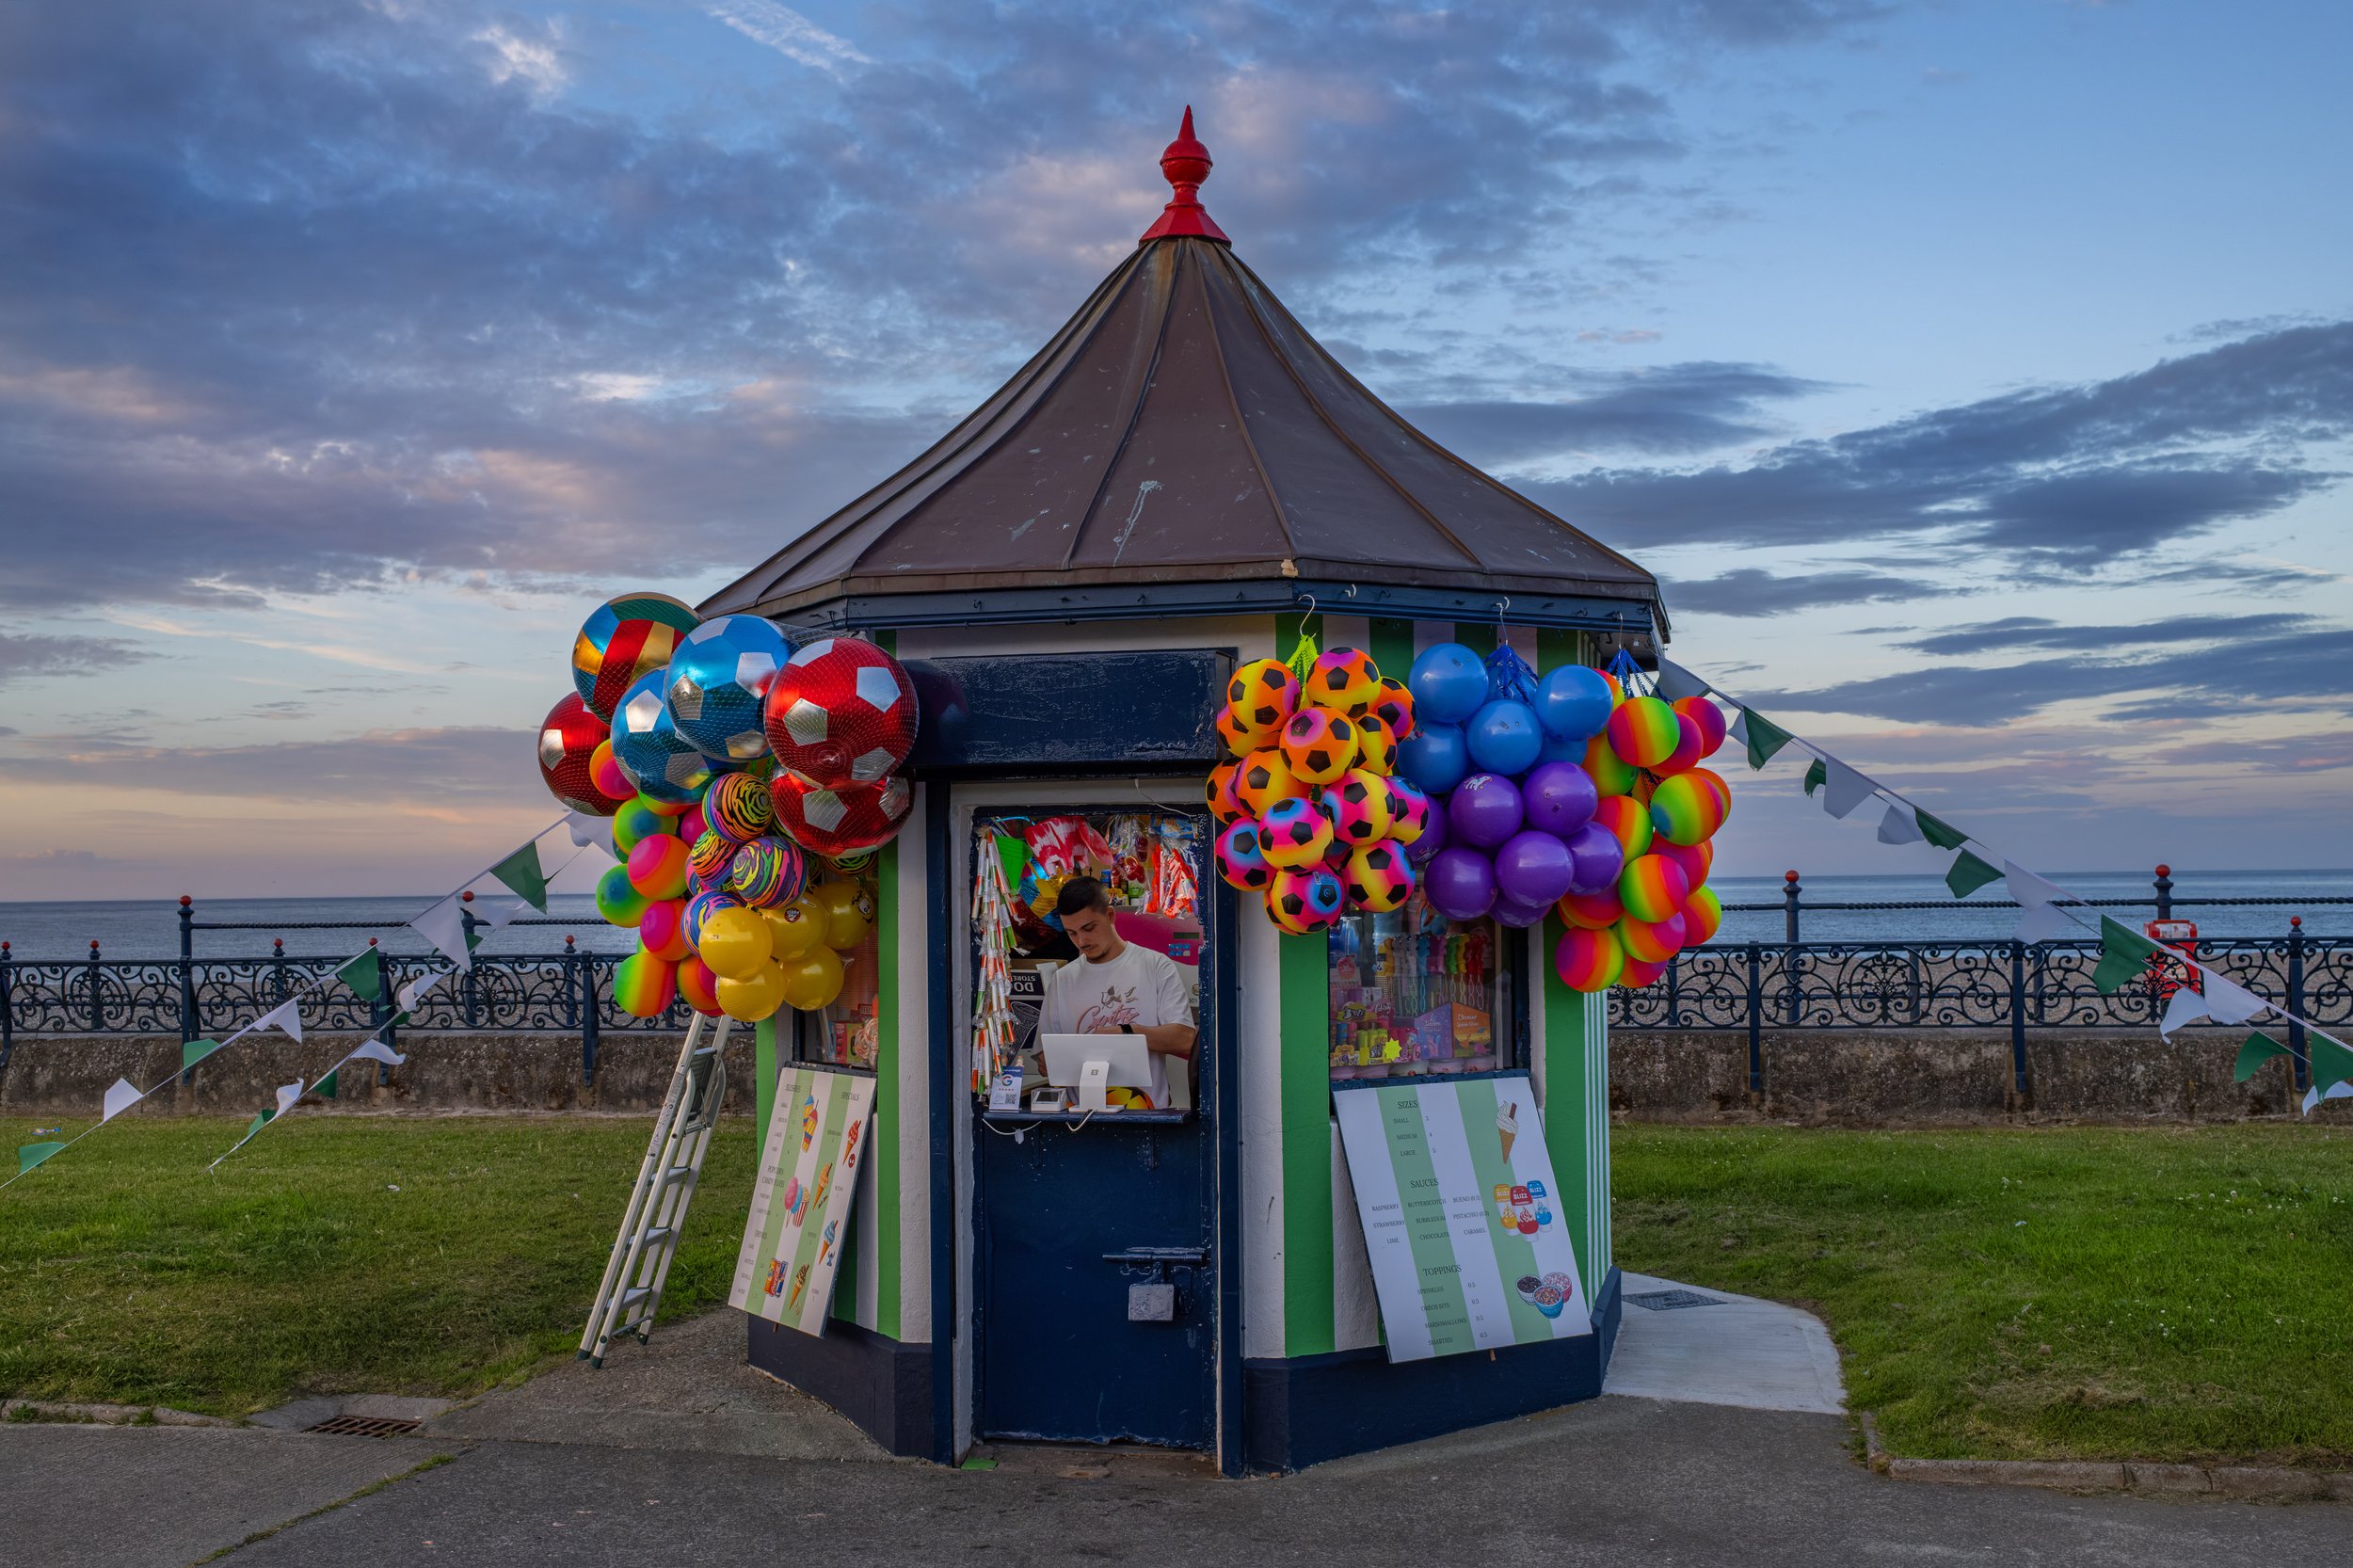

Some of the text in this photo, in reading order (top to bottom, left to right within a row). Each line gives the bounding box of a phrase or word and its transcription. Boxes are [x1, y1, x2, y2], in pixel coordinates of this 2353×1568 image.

[1397, 1099, 1418, 1110] SIZES
[1409, 1177, 1439, 1189] SAUCES
[1371, 1204, 1400, 1212] RASPBERRY
[1407, 1198, 1447, 1208] BUTTERSCOTCH
[1452, 1211, 1479, 1220] PISTACHIO
[1372, 1220, 1405, 1229] STRAWBERRY
[1419, 1231, 1450, 1241] CHOCOLATE
[1463, 1227, 1487, 1236] CARAMEL
[1422, 1264, 1462, 1277] TOPPINGS
